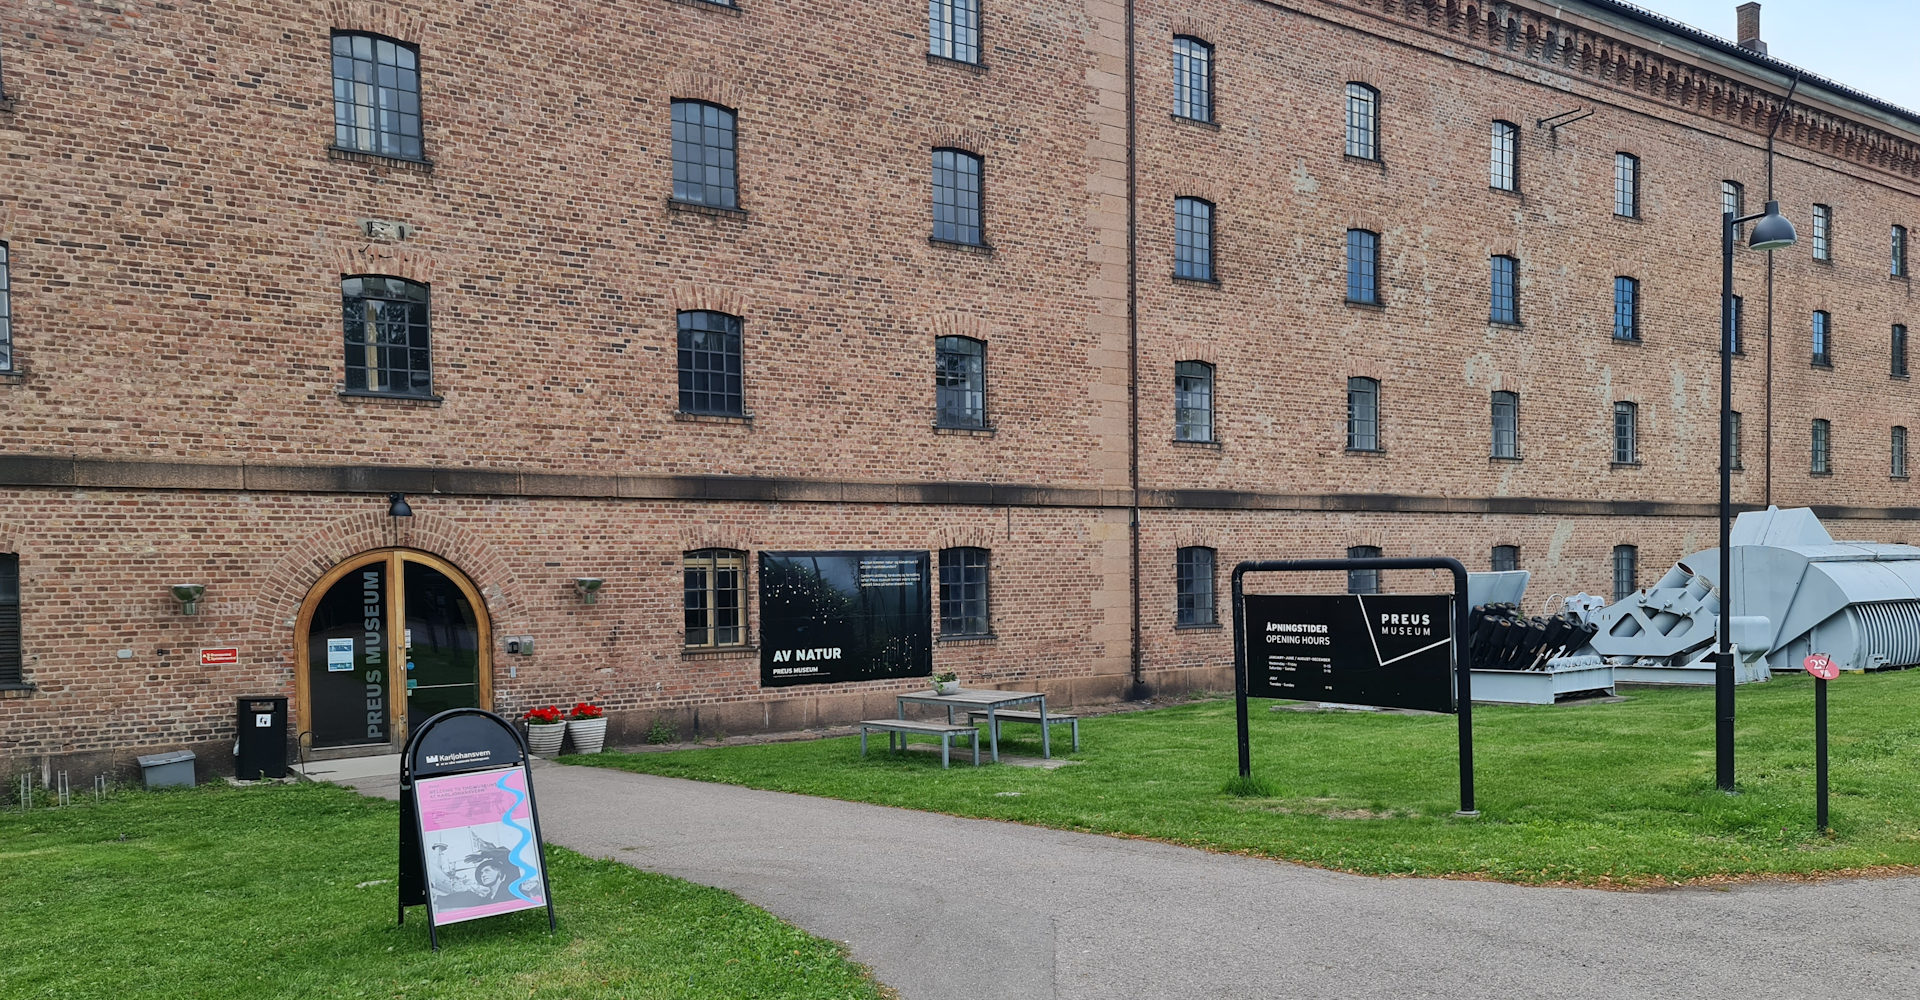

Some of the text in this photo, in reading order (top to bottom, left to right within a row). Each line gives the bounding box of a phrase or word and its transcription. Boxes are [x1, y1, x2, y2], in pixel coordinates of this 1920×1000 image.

[1266, 621, 1328, 634] ÅPNINGSTIDER
[1381, 613, 1431, 636] PREUS MUSEUM
[1266, 635, 1331, 646] OPENING HOURS
[363, 571, 383, 739] PREUS MUSEUM
[772, 647, 842, 662] AV NATUR
[772, 667, 793, 675] PREUS
[793, 666, 819, 674] MUSEUM
[439, 750, 491, 762] Karljohansvern
